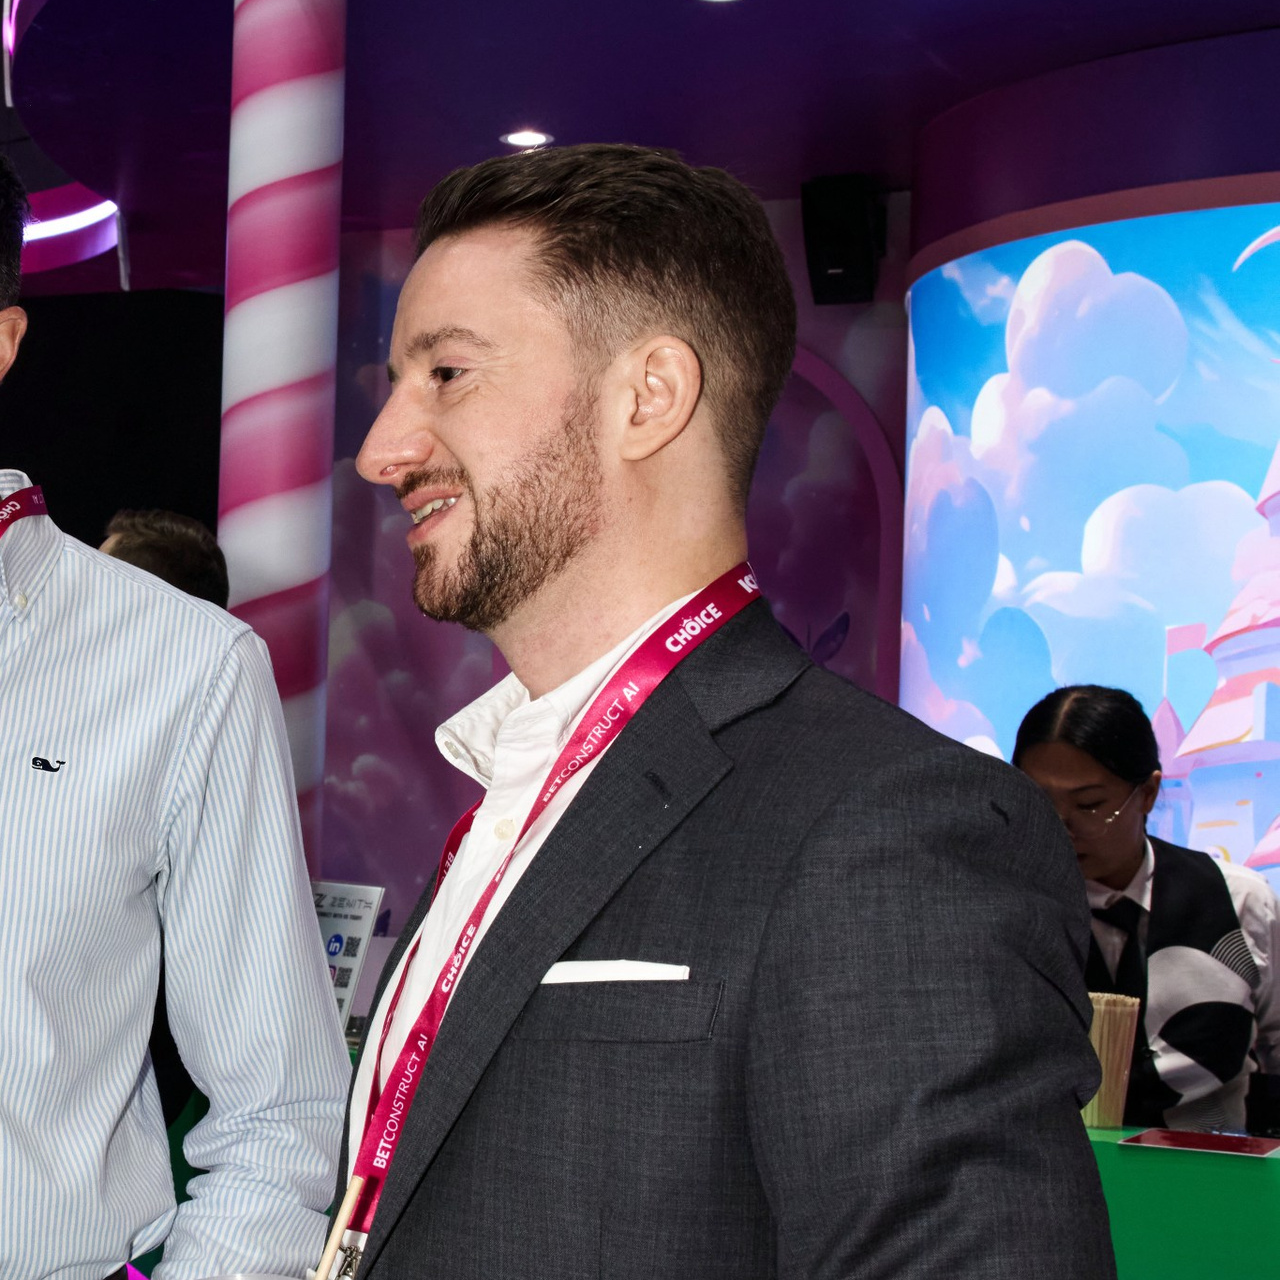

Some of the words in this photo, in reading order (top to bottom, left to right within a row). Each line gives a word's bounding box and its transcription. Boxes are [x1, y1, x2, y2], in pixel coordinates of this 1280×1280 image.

[665, 602, 722, 653] CHOICE
[542, 698, 625, 803] BETCONSTRUCT
[622, 681, 640, 702] AI
[330, 897, 373, 910] ZENITH
[441, 923, 476, 993] CHOICE
[373, 1052, 420, 1169] BETCONSTRUCT
[417, 1033, 428, 1051] AI
